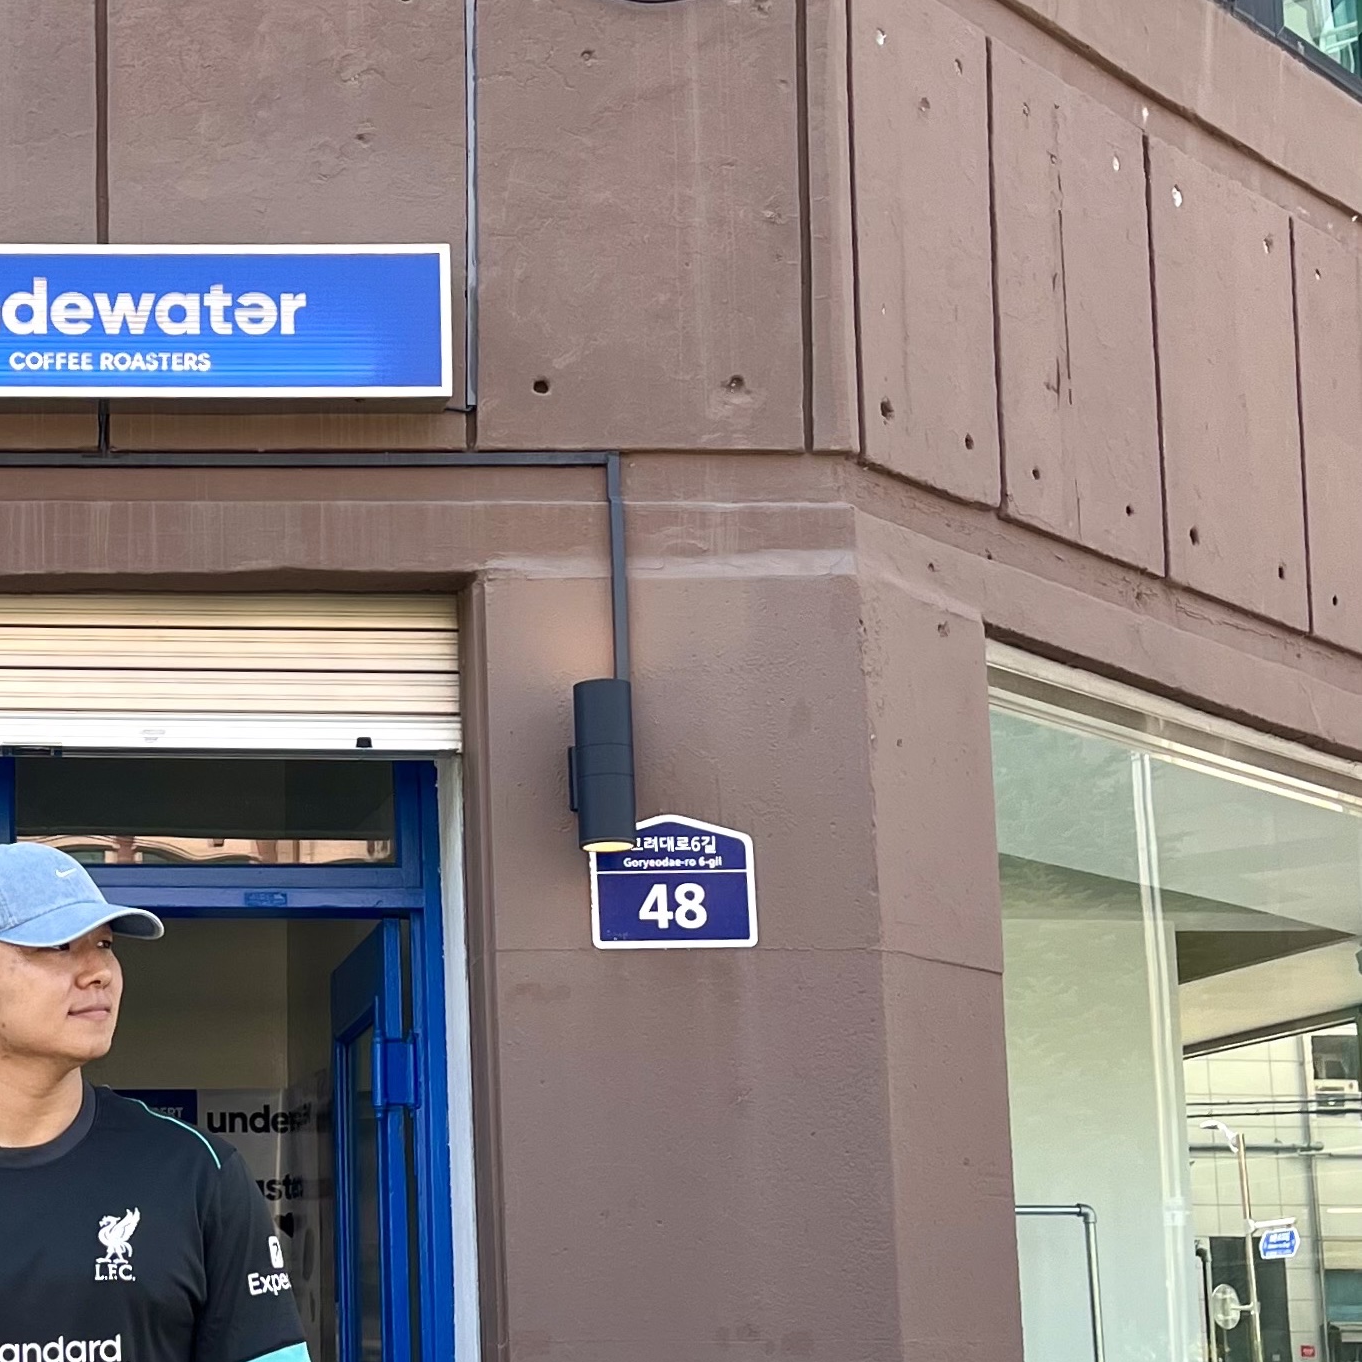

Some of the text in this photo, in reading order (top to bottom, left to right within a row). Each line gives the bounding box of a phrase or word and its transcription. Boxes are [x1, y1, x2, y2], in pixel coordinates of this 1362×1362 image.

[9, 351, 211, 372] COFFEE ROASTERS
[623, 856, 723, 869] Goryeodae-ro 6-gil
[639, 882, 708, 929] 48
[247, 1272, 291, 1296] Expe
